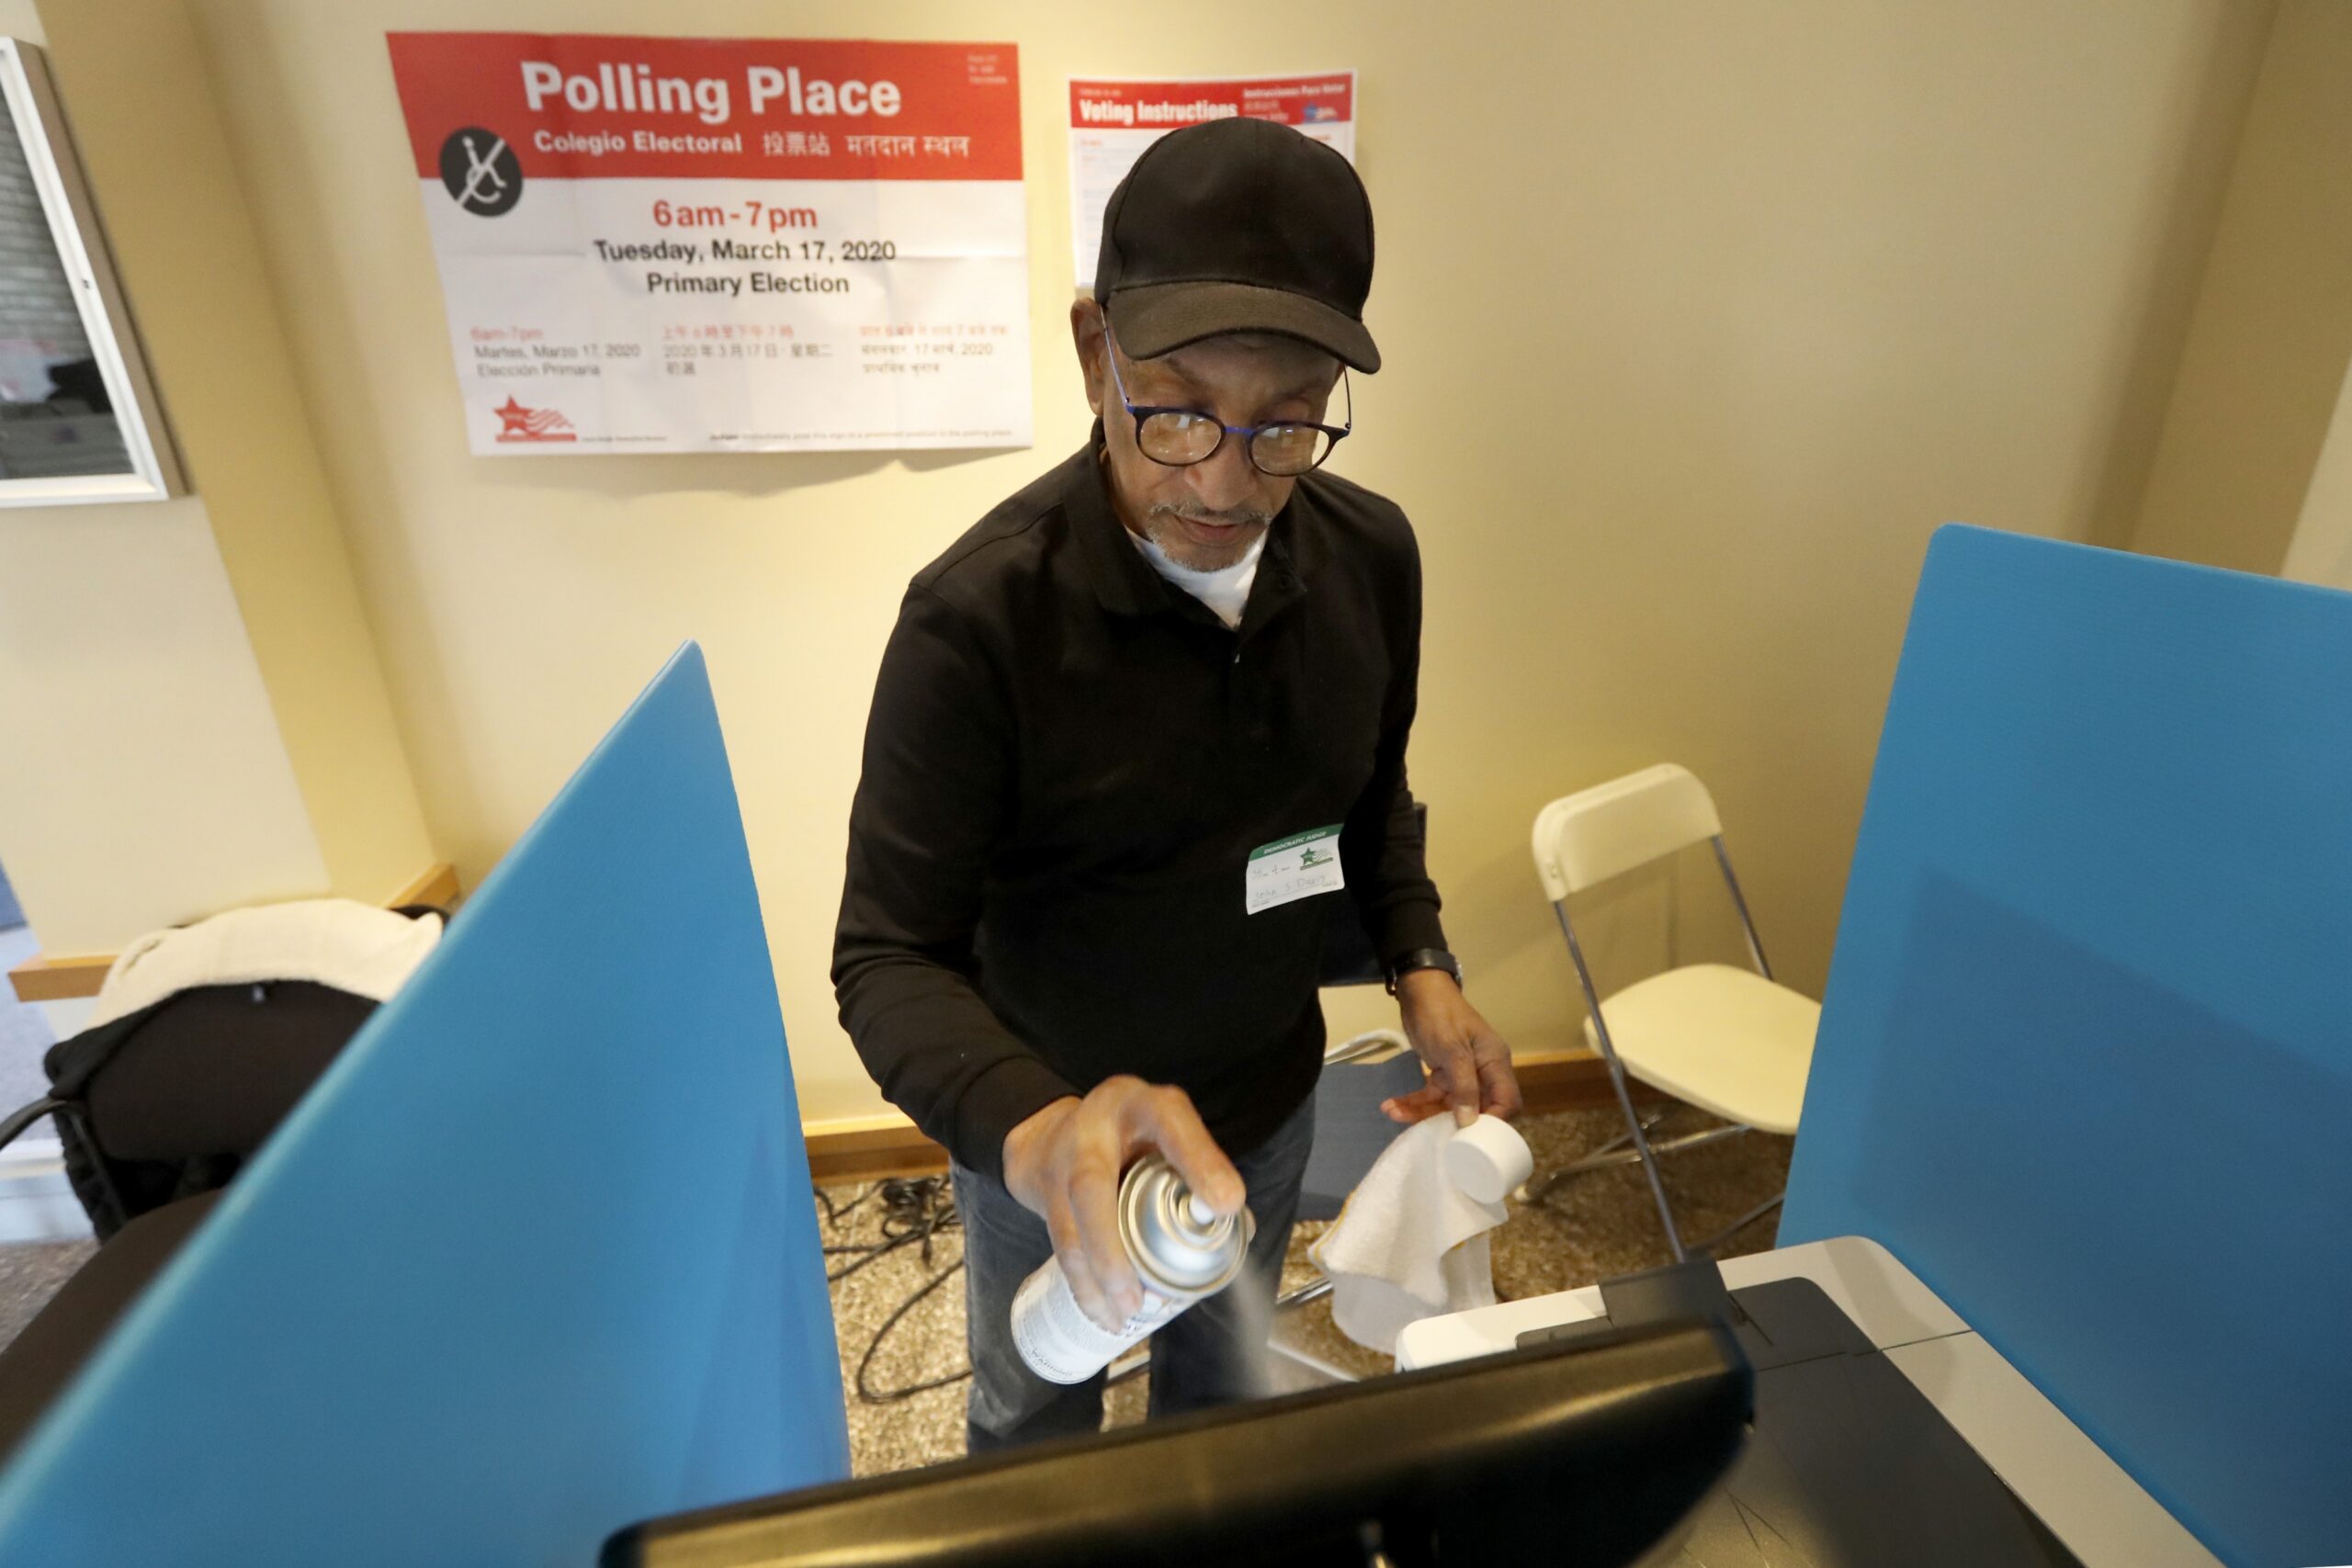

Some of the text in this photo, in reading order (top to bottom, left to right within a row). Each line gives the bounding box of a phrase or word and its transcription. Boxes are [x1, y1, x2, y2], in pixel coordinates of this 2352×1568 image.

[520, 61, 901, 124] Polling Place
[1080, 98, 1134, 126] Voting
[1137, 99, 1238, 121] Instructions
[534, 130, 742, 156] Colegio Electoral
[763, 131, 831, 156] 投票站
[844, 135, 917, 157] मतदान
[594, 239, 897, 264] Tuesday, March 17, 2020
[647, 272, 850, 297] Primary Election
[533, 344, 578, 357] Marzo
[605, 343, 640, 357] 2020
[542, 363, 600, 377] Primaria
